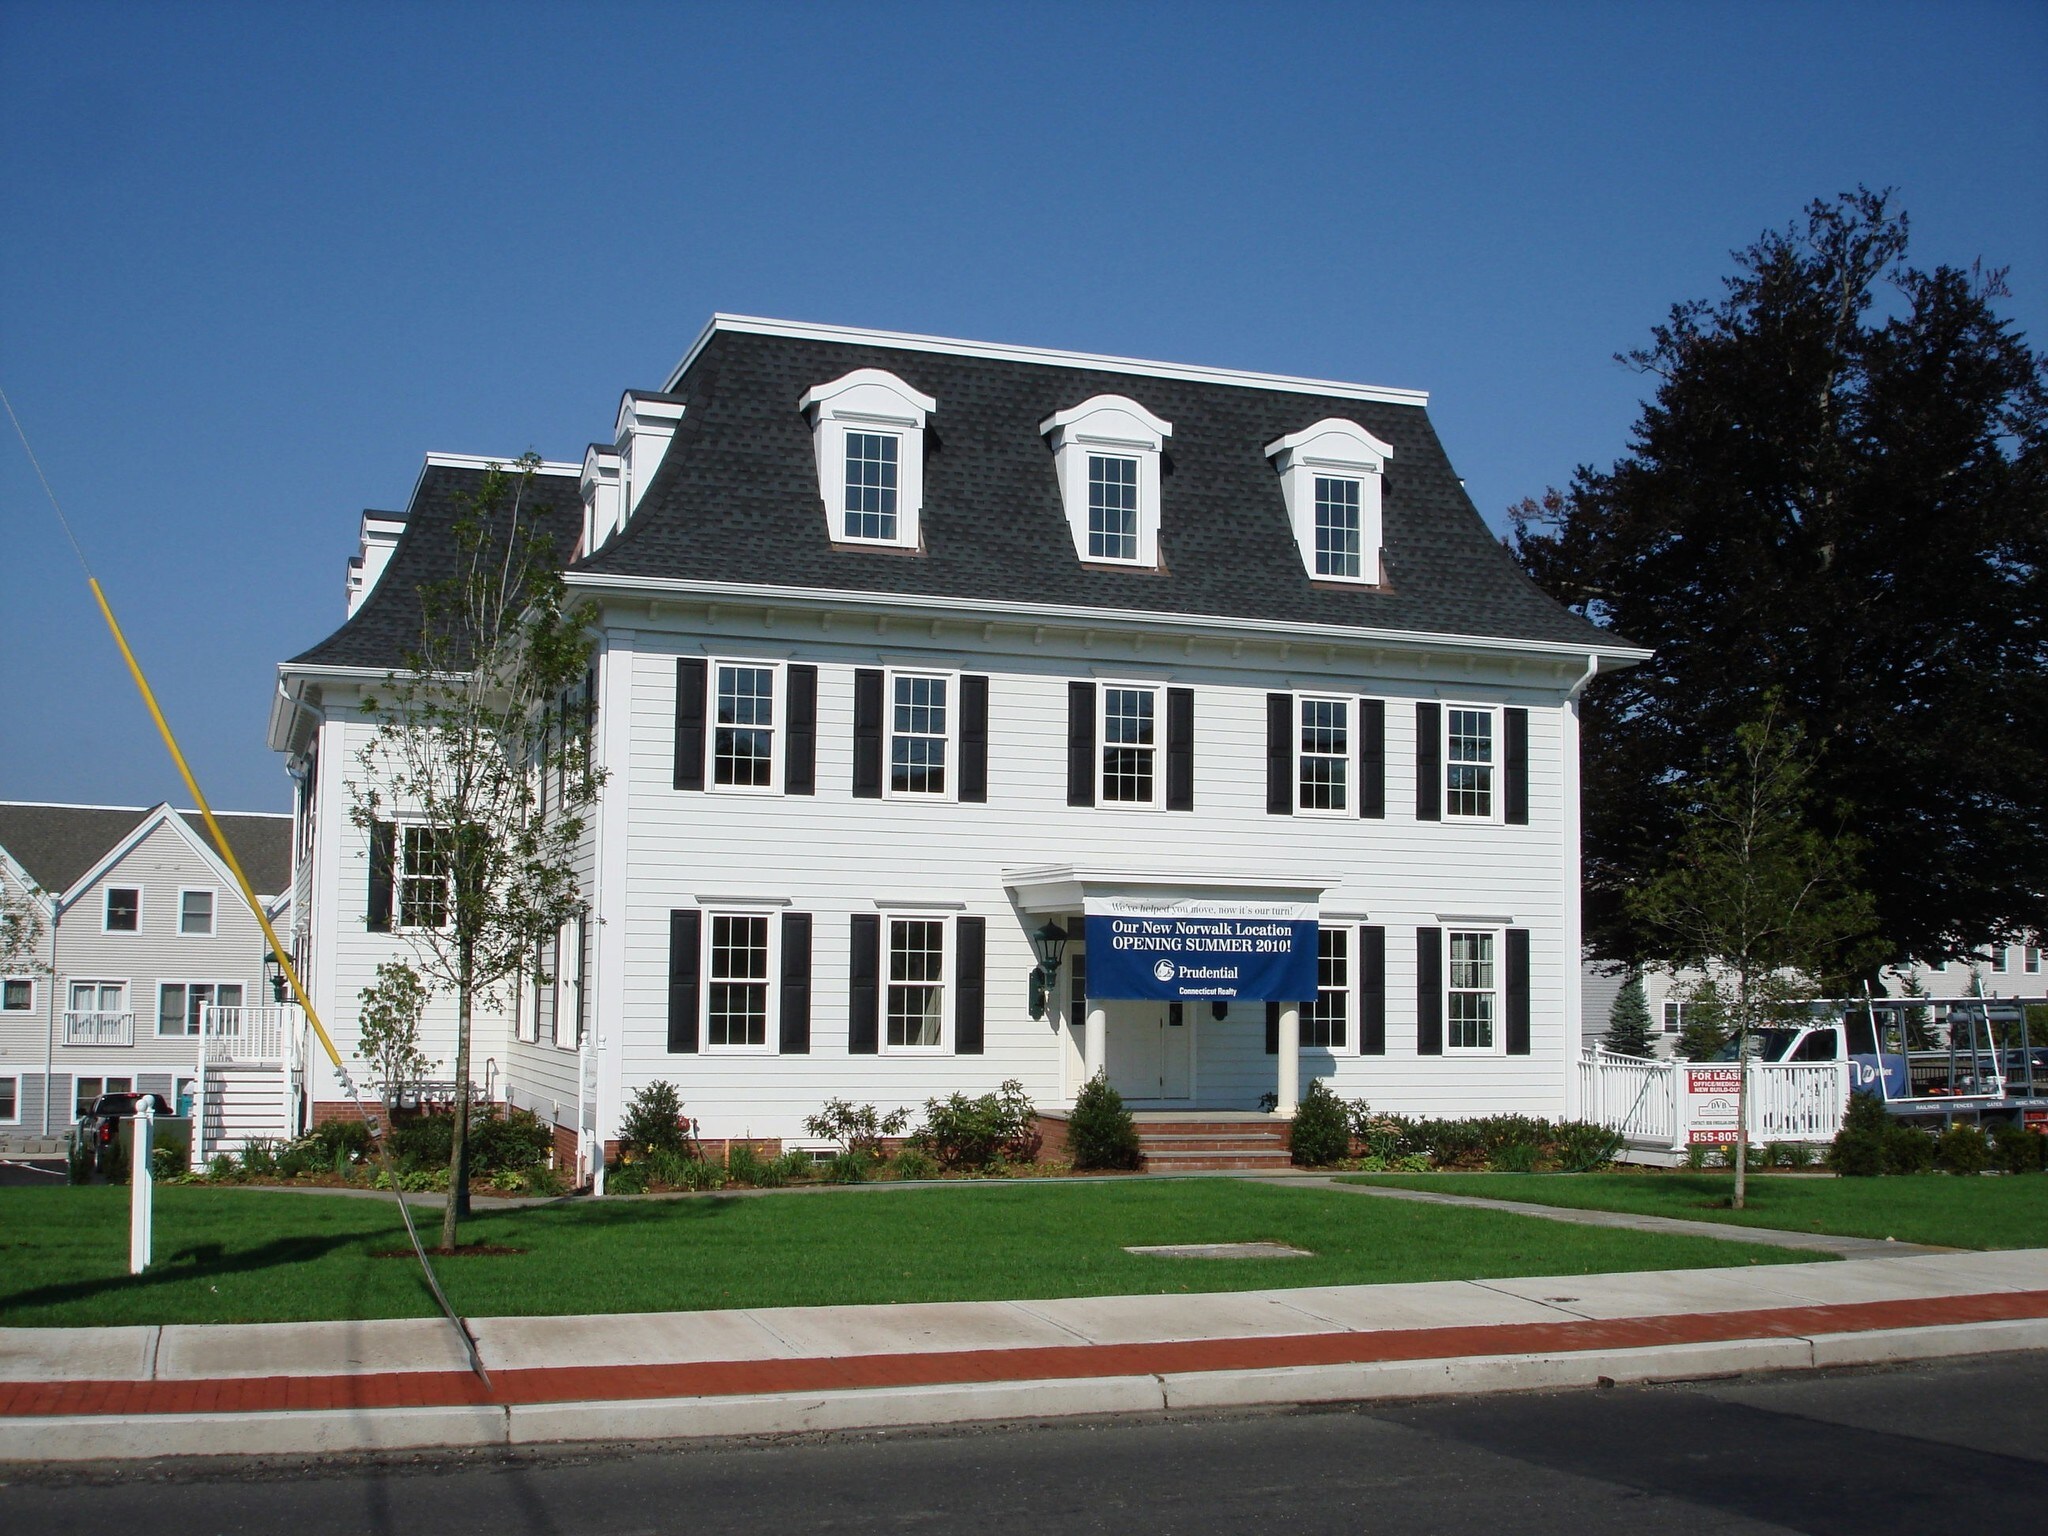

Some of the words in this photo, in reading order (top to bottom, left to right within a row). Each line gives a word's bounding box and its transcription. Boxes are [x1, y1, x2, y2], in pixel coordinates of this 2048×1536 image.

[1112, 902, 1138, 913] We've
[1140, 904, 1170, 915] helped
[1172, 906, 1188, 915] you
[1191, 906, 1216, 915] move,
[1219, 906, 1237, 914] now
[1239, 905, 1252, 915] it's
[1255, 907, 1269, 915] our
[1272, 907, 1293, 915] turn!
[1112, 920, 1139, 933] Our
[1142, 921, 1172, 934] New
[1175, 922, 1232, 935] Norwalk
[1236, 924, 1292, 936] Location
[1112, 936, 1182, 950] OPENING
[1186, 937, 1252, 952] SUMMER
[1256, 940, 1291, 952] 2010!
[1179, 966, 1238, 979] Prudential
[1179, 987, 1216, 996] Connecticut
[1218, 987, 1237, 997] Realty
[1693, 1132, 1739, 1141] 855-805
